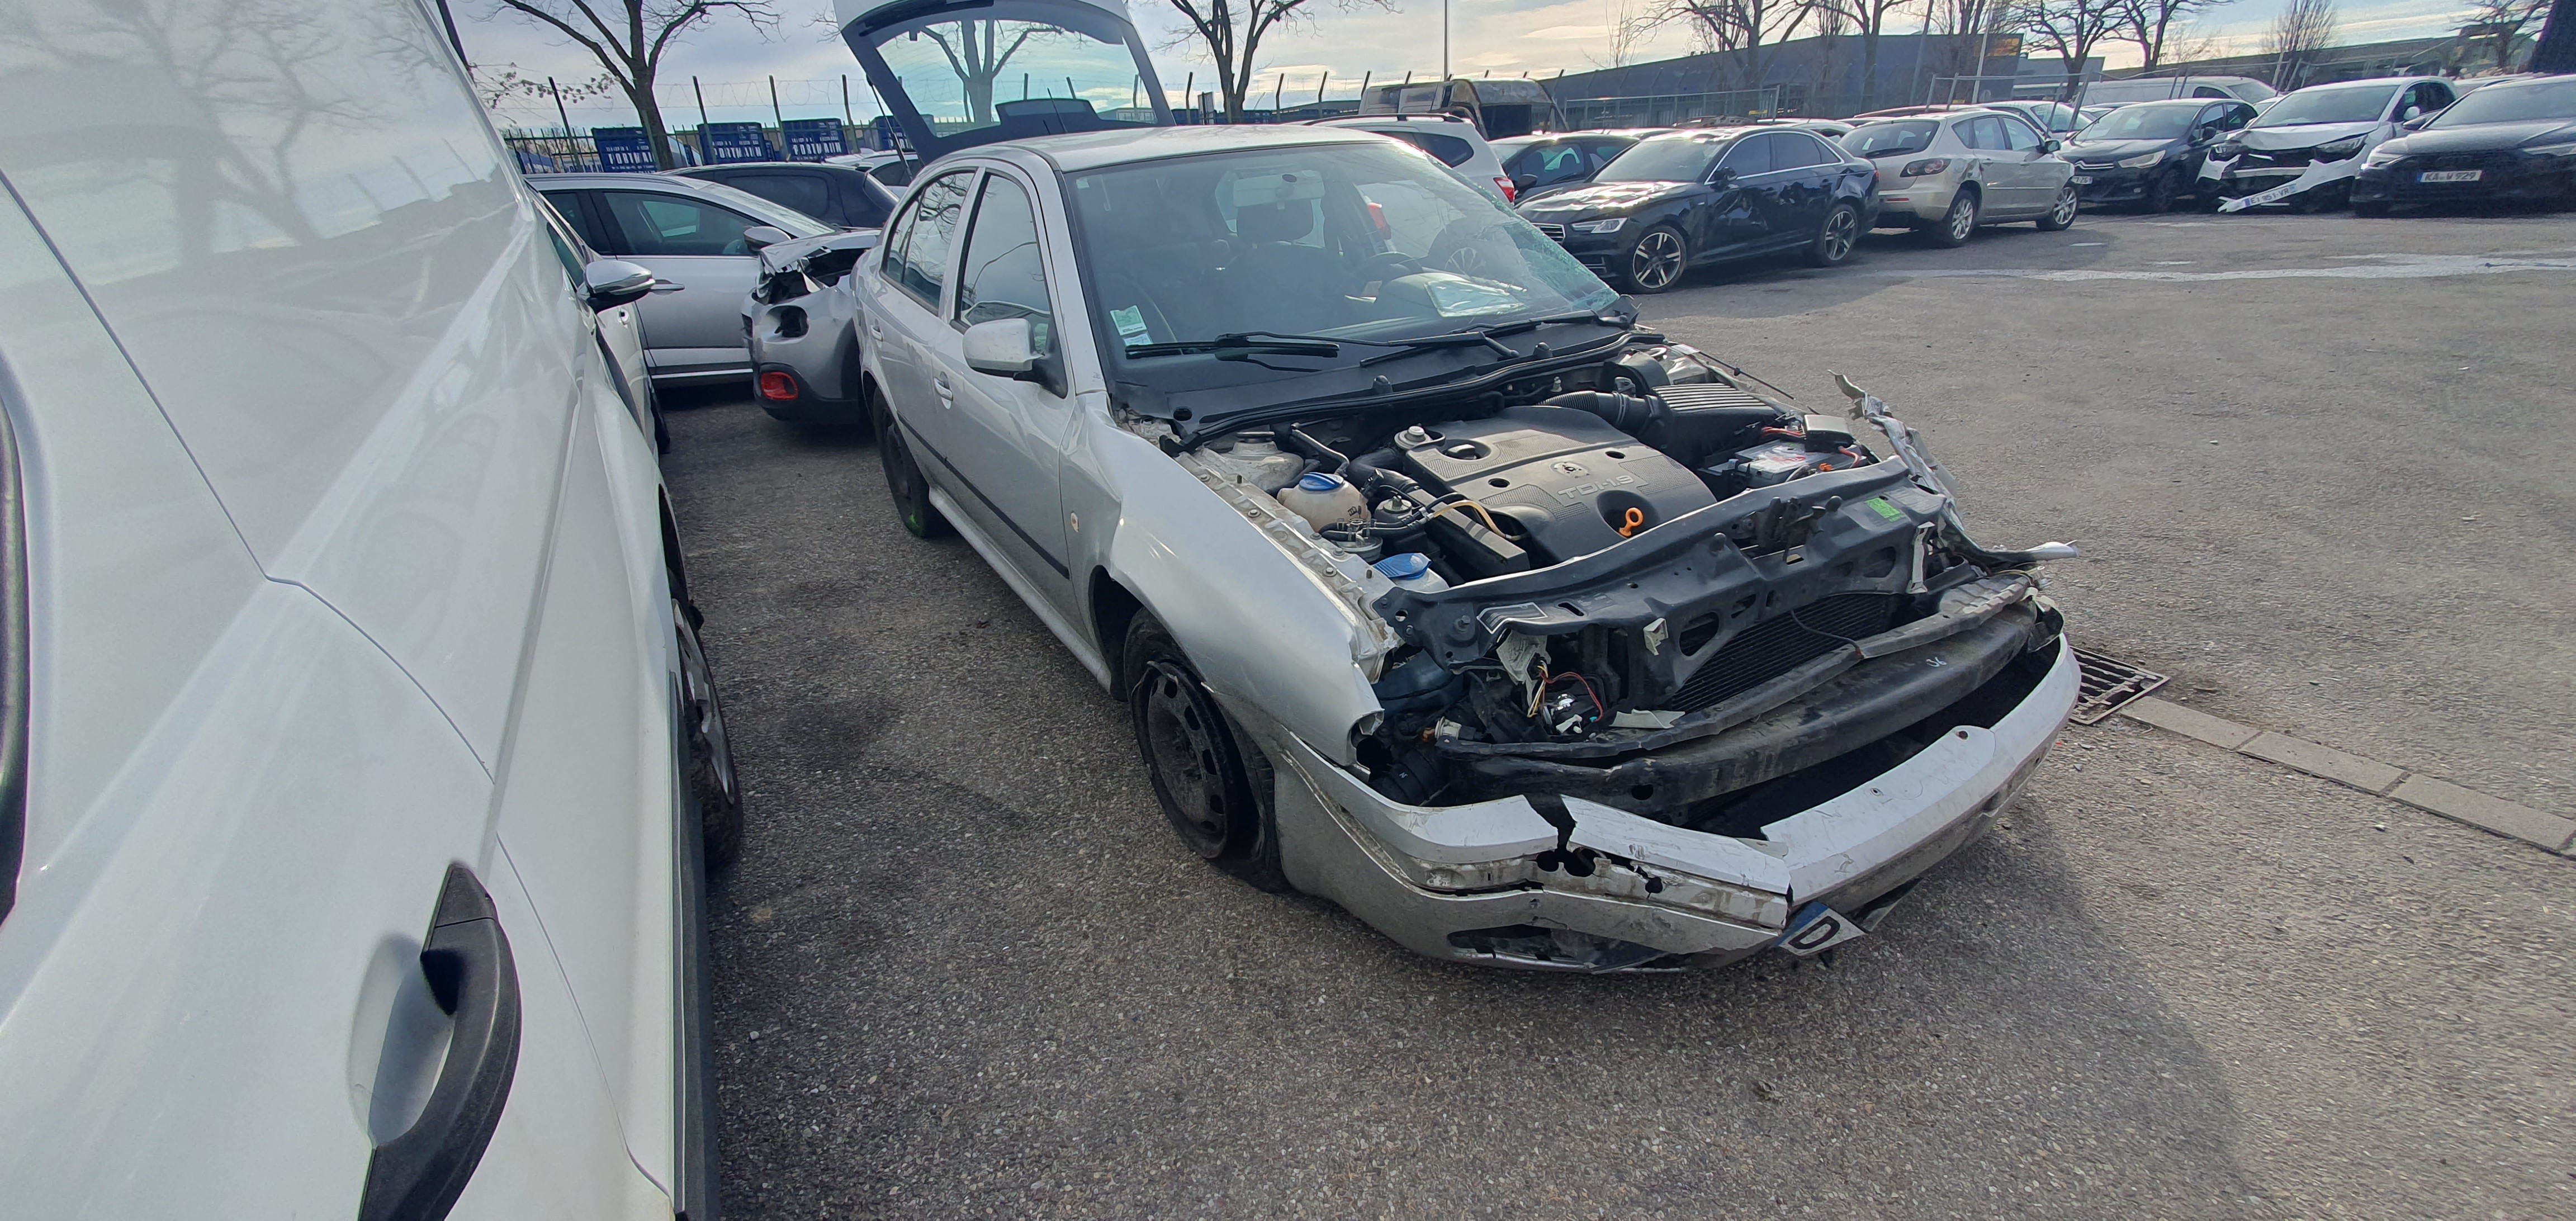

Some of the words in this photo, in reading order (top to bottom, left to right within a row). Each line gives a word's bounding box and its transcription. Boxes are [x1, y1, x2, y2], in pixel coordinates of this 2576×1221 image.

[608, 152, 656, 165] PORTMAN
[1557, 475, 1635, 499] TDI-1.9
[1788, 915, 1841, 949] D
